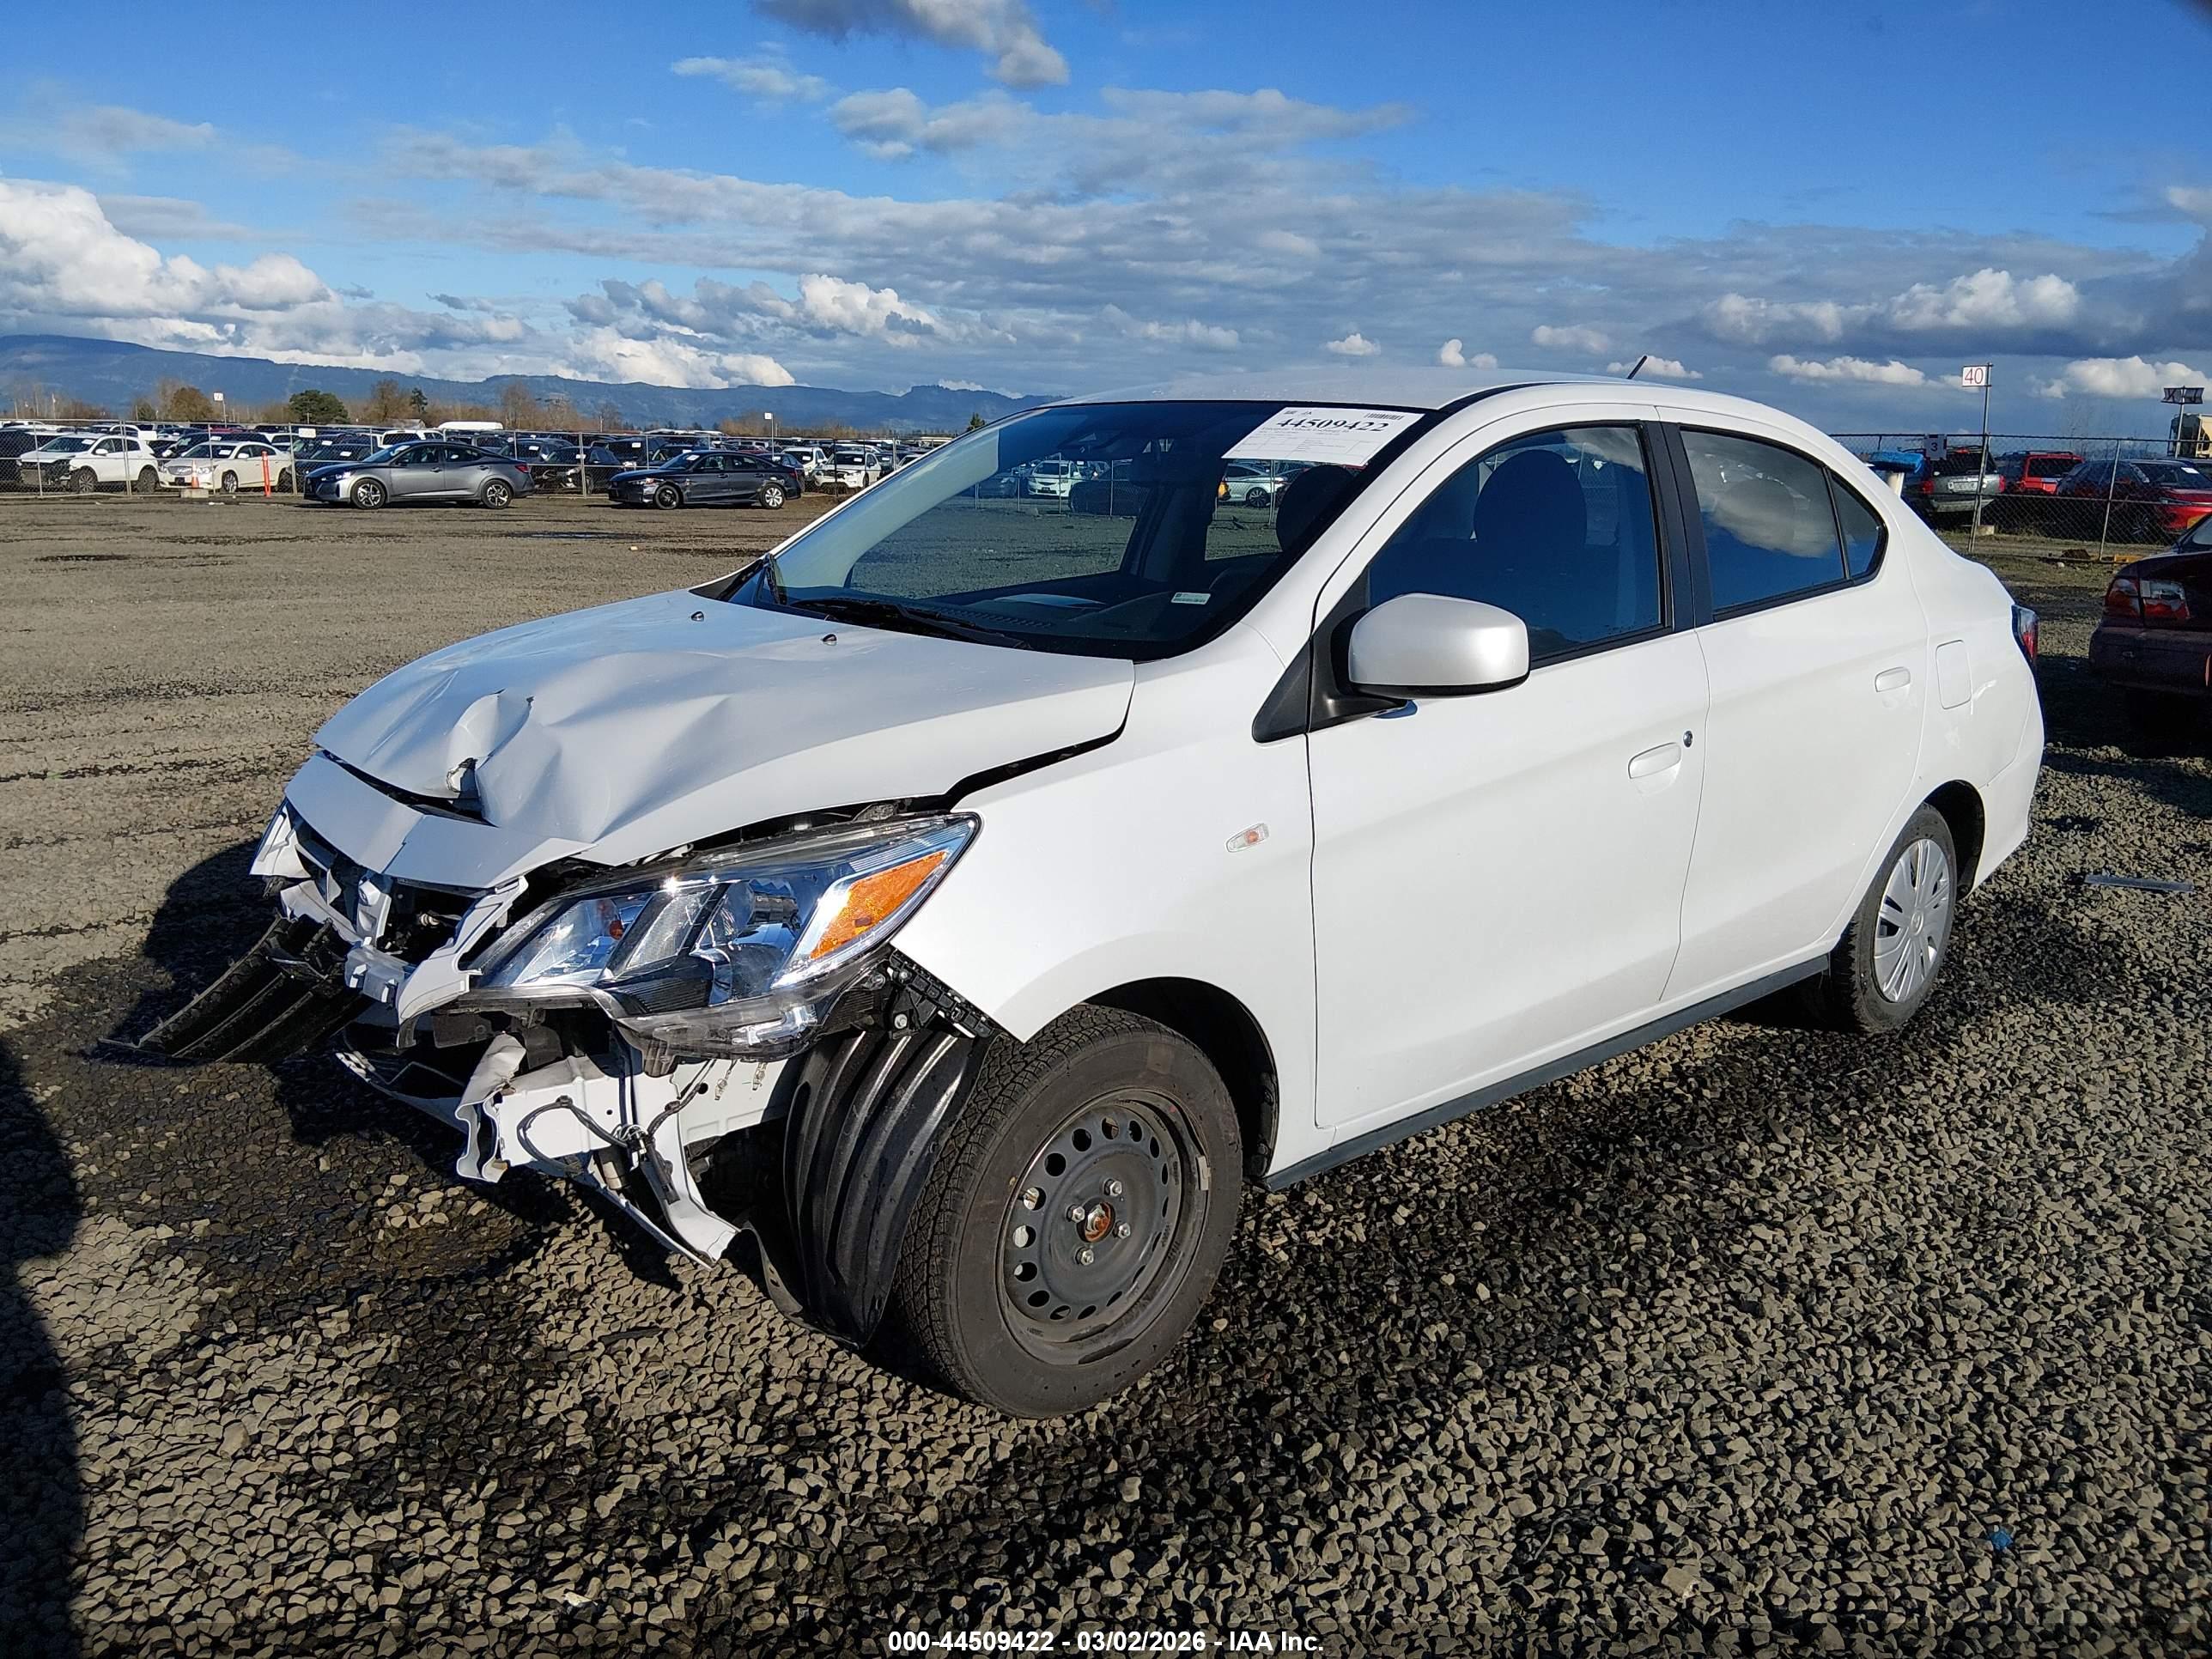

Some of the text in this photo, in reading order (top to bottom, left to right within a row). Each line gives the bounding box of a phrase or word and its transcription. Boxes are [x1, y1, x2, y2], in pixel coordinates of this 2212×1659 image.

[1964, 368, 1984, 384] 40
[1277, 417, 1389, 432] 44509422
[1930, 442, 1938, 452] 3
